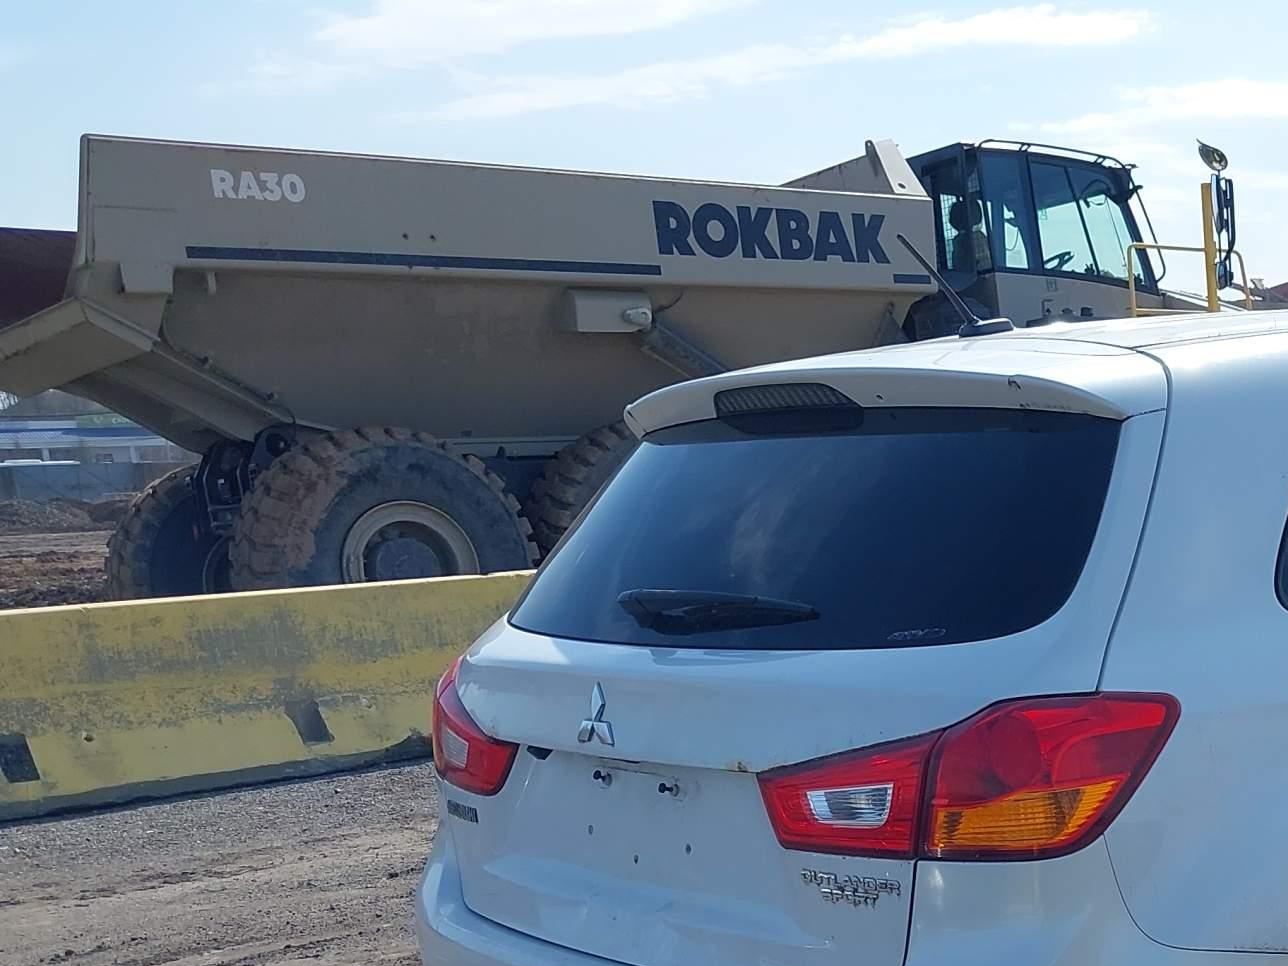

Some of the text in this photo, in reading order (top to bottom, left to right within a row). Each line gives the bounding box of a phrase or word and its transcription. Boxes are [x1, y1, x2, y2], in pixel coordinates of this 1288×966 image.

[210, 168, 306, 203] RA30
[652, 200, 891, 264] ROKBAK
[801, 868, 901, 897] OUTLANDER
[820, 887, 879, 909] SPORT
